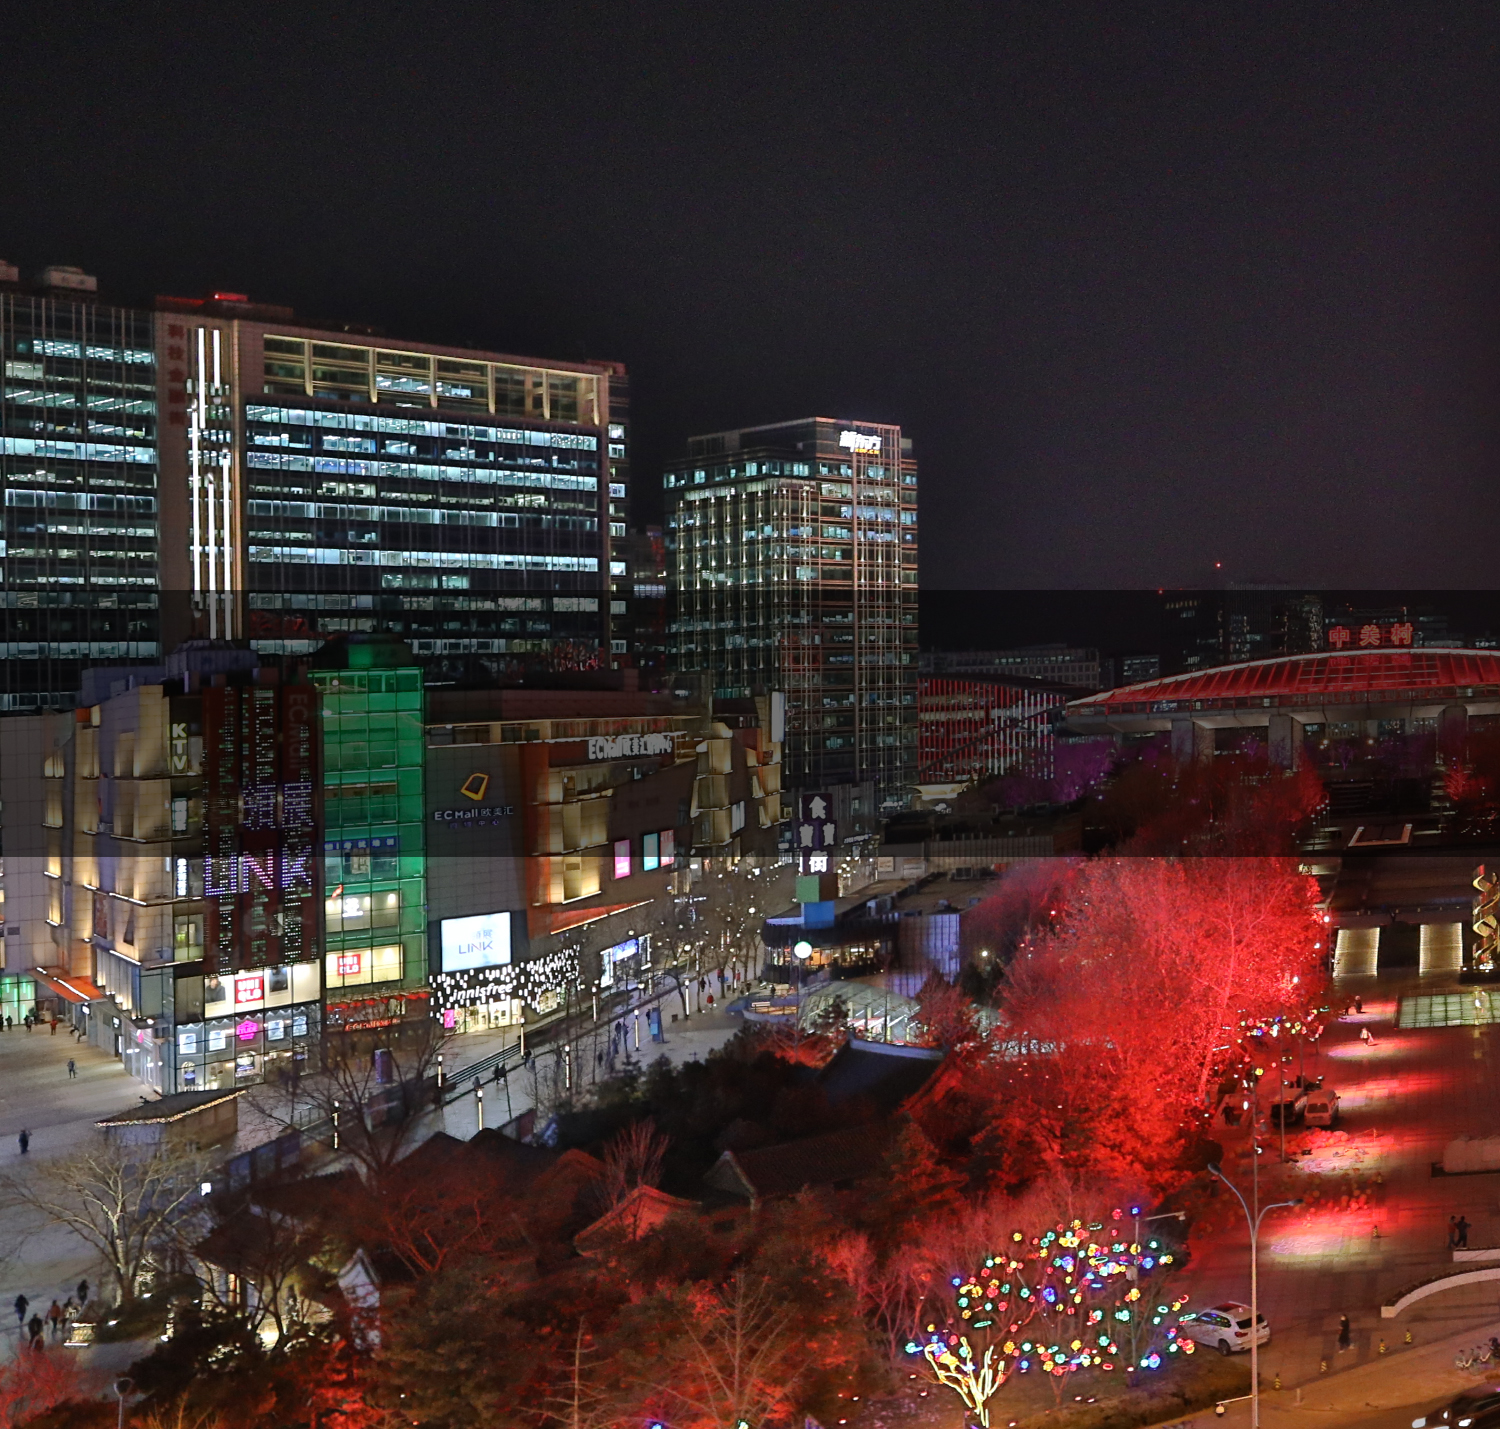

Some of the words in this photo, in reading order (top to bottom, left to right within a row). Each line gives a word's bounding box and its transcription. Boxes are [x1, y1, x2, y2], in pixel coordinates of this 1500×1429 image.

[839, 430, 882, 453] 新东方
[172, 723, 188, 770] KTV
[480, 806, 514, 817] 欧美汇
[205, 845, 313, 896] LINK
[459, 940, 493, 955] LINK
[237, 989, 262, 1002] QLO
[453, 982, 514, 1001] innisfree
